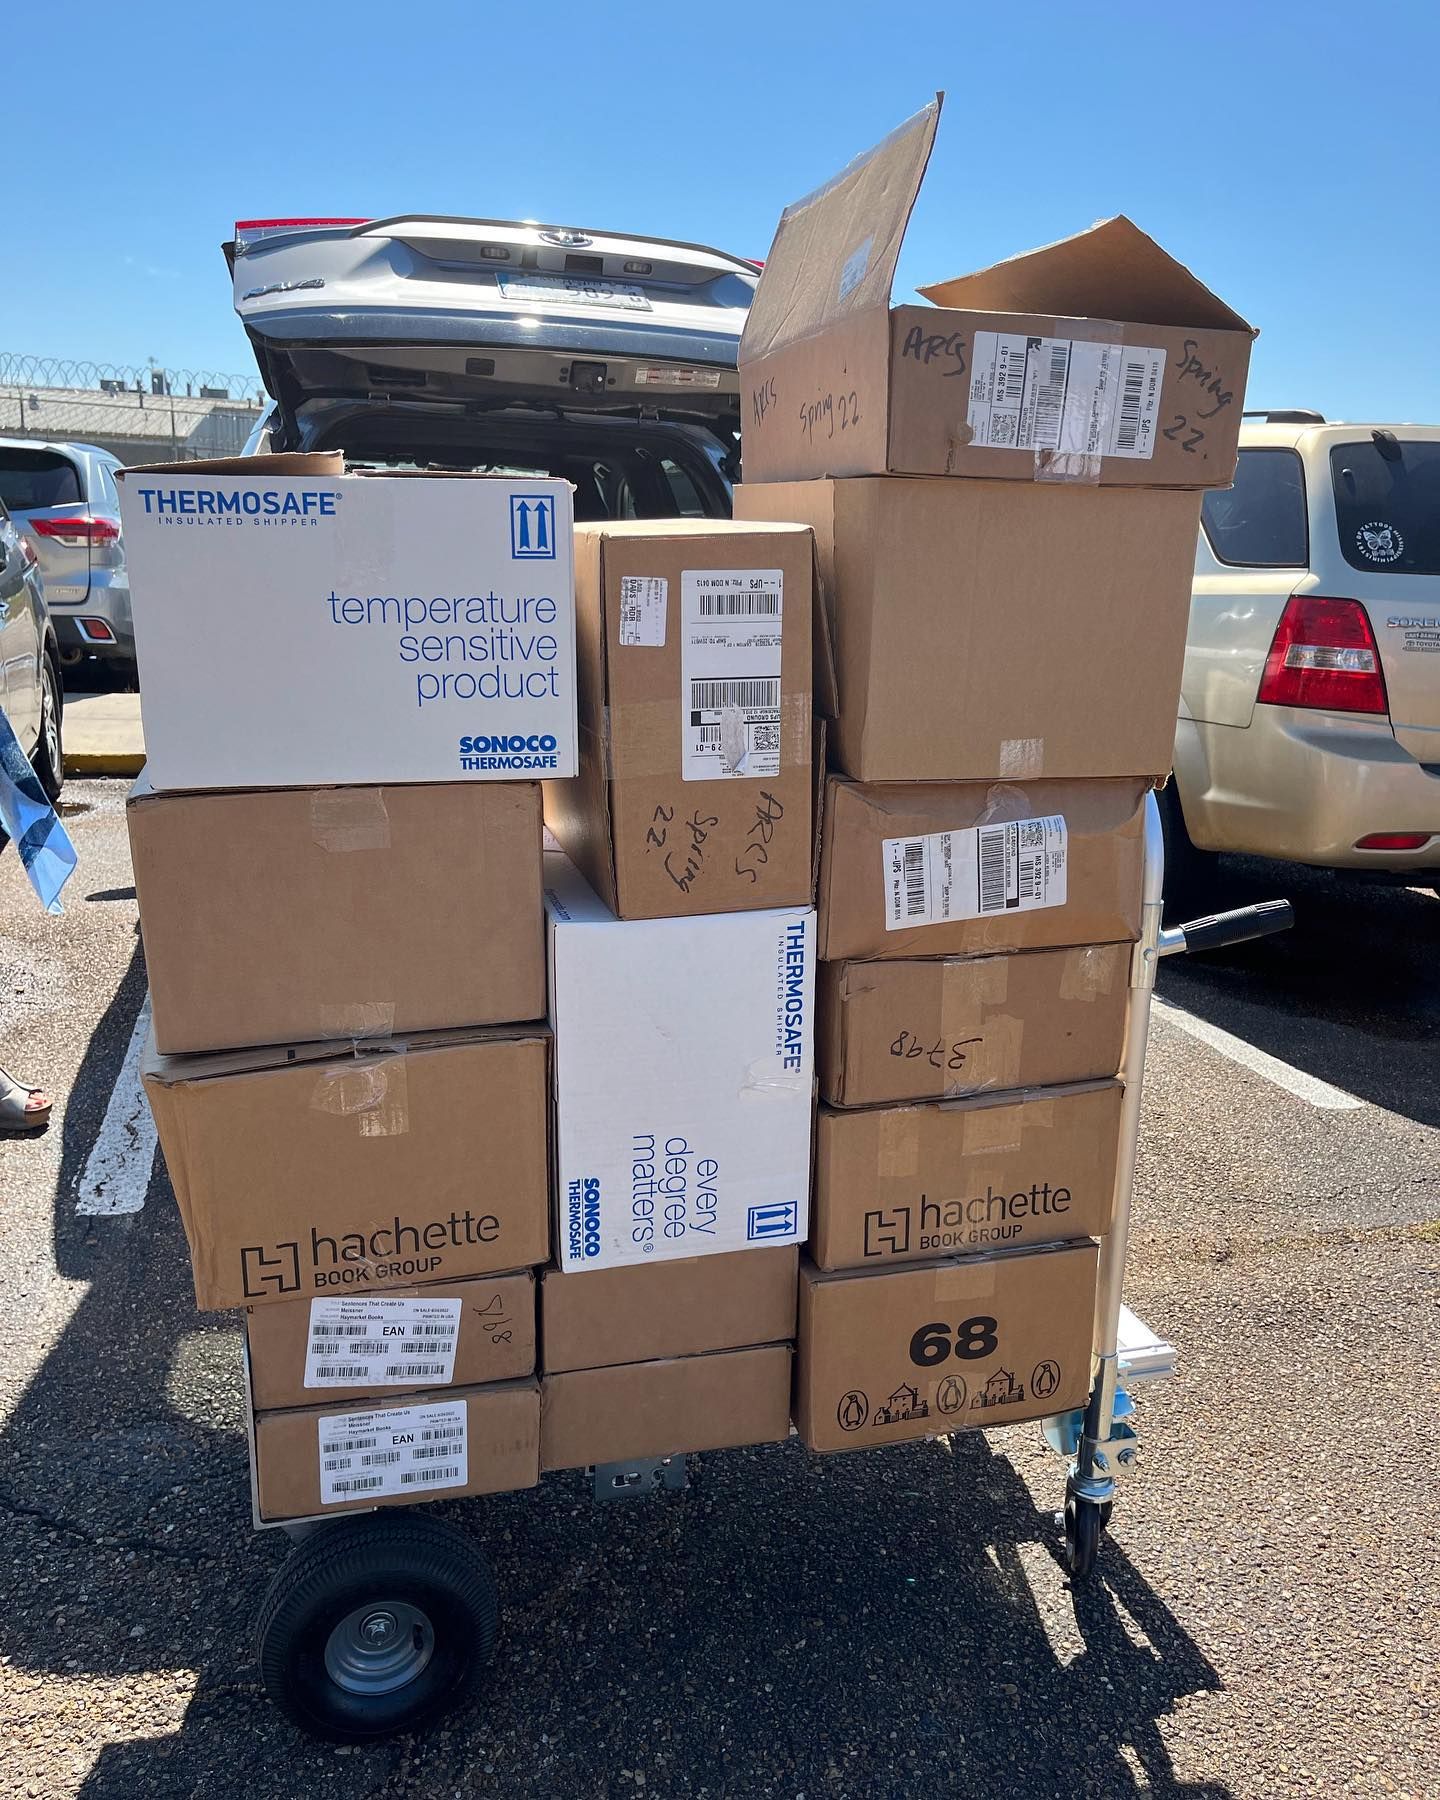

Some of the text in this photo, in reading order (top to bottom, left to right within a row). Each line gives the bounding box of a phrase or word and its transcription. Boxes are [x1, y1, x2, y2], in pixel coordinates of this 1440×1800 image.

[996, 389, 1004, 402] MS
[998, 371, 1006, 386] 392
[1176, 339, 1234, 419] Spring
[800, 387, 834, 444] Spring
[1019, 408, 1028, 446] UPS GROUND
[158, 516, 318, 526] INSULATED SHIPPER
[1360, 522, 1392, 531] TATTOOS
[327, 590, 556, 631] temperature
[400, 628, 558, 662] sensitive
[418, 666, 559, 707] product
[460, 735, 557, 753] SONOCO
[460, 755, 558, 770] THERMOSAFE
[664, 810, 720, 894] Spring
[1035, 856, 1041, 866] MS
[776, 935, 784, 1000] INSULATED
[890, 1031, 982, 1070] 3798
[658, 1137, 693, 1238] degree
[690, 1158, 718, 1234] every
[920, 1182, 1071, 1229] hachette
[569, 1180, 581, 1259] THERMOSAFE
[584, 1178, 600, 1256] SONOCO
[920, 1224, 1023, 1249] BOOK GROUP
[312, 1210, 500, 1266] hachette
[314, 1256, 442, 1288] BOOK GROUP
[383, 1327, 405, 1336] EAN
[909, 1315, 998, 1367] 68
[392, 1434, 414, 1445] EAN
